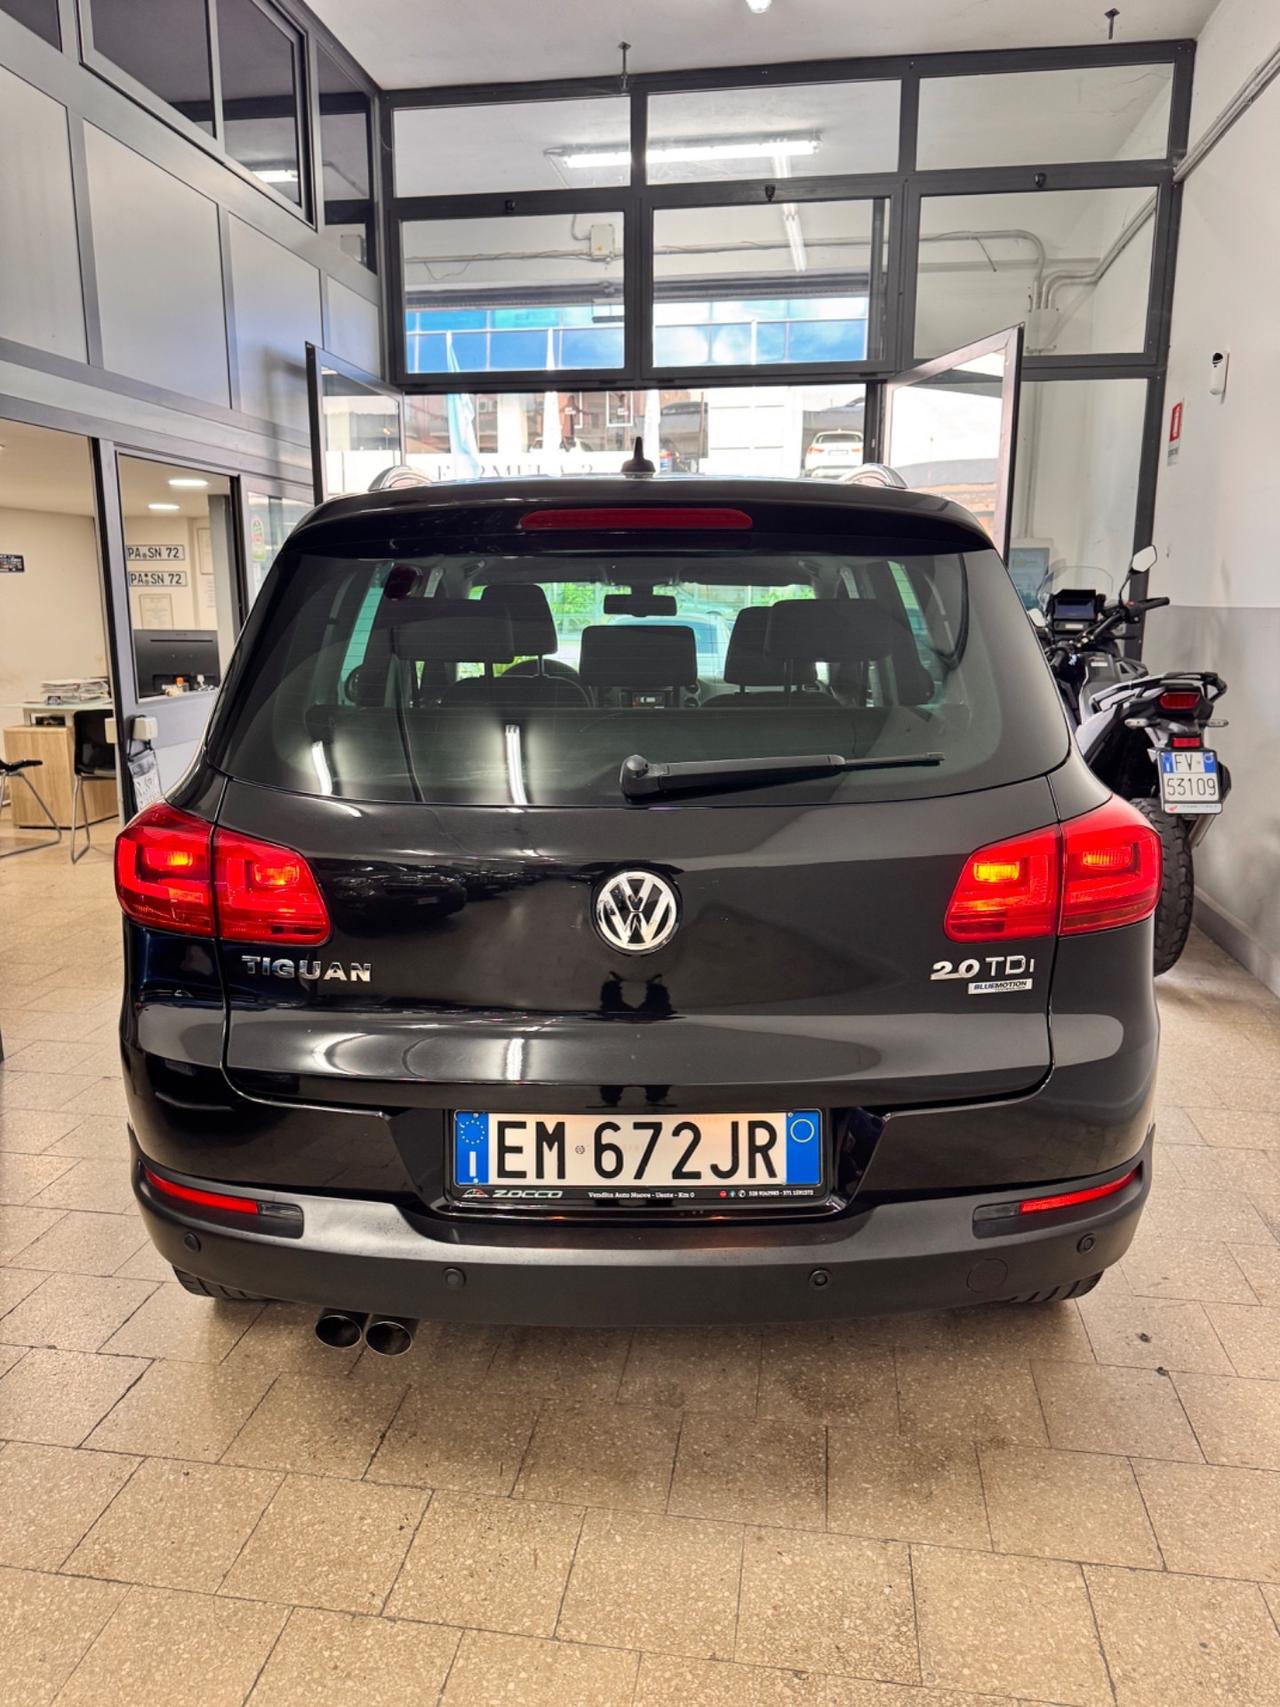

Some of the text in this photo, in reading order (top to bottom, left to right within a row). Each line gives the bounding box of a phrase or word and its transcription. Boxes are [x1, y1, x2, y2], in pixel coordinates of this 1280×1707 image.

[128, 547, 180, 559] PA SN 72
[130, 572, 182, 585] PA SN 72
[1174, 753, 1193, 772] FV
[1167, 778, 1217, 796] 53109
[241, 955, 372, 982] TIGUAN
[973, 980, 1027, 990] BLUEMOTION
[496, 1120, 778, 1180] EM 672 JR
[492, 1190, 563, 1199] ZOCCO
